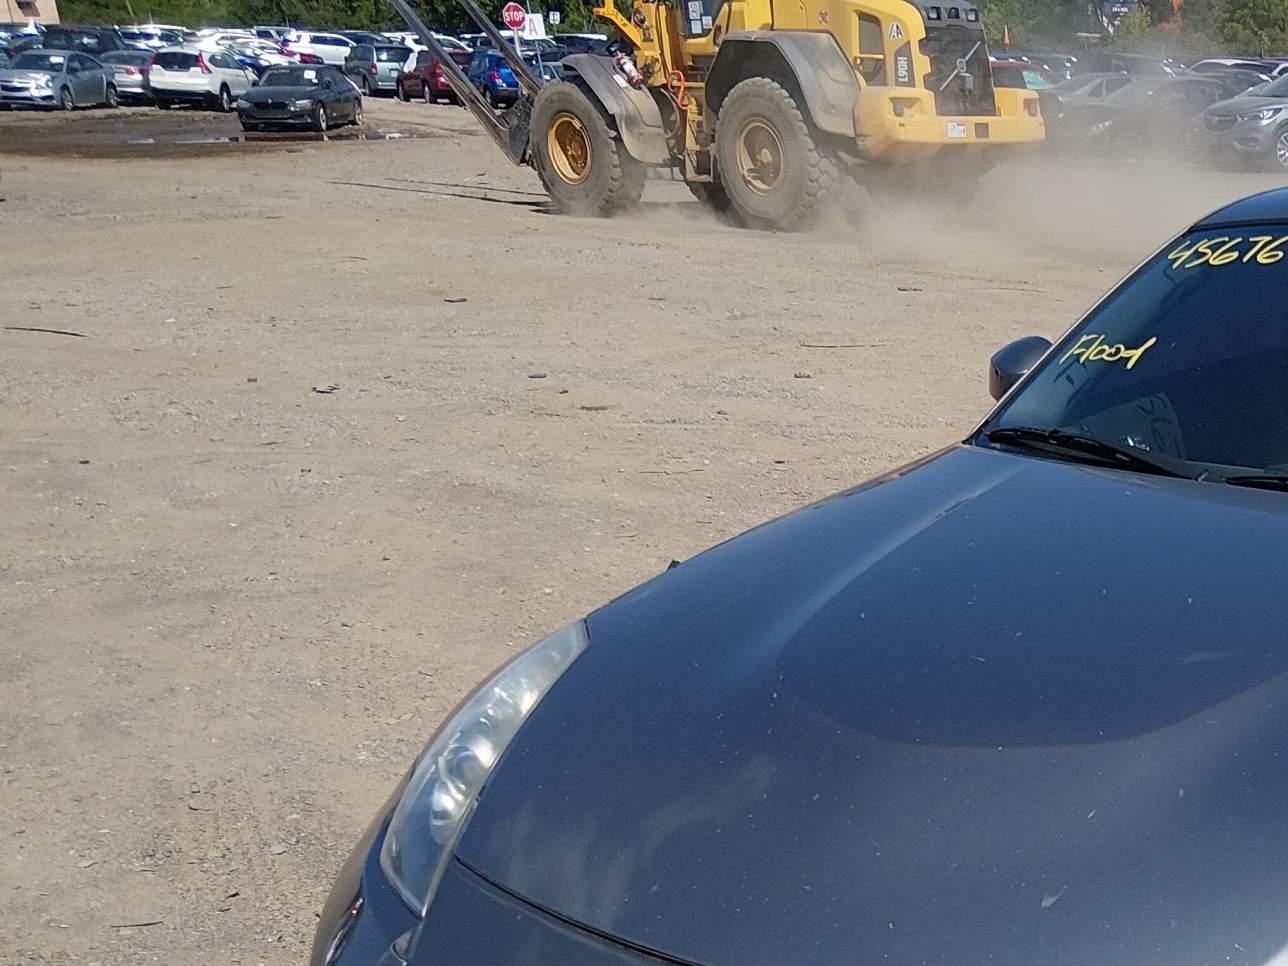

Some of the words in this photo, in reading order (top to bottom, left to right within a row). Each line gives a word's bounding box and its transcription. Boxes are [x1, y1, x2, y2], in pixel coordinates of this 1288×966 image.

[504, 11, 524, 22] STOP
[529, 18, 538, 36] A
[897, 56, 909, 82] L90H
